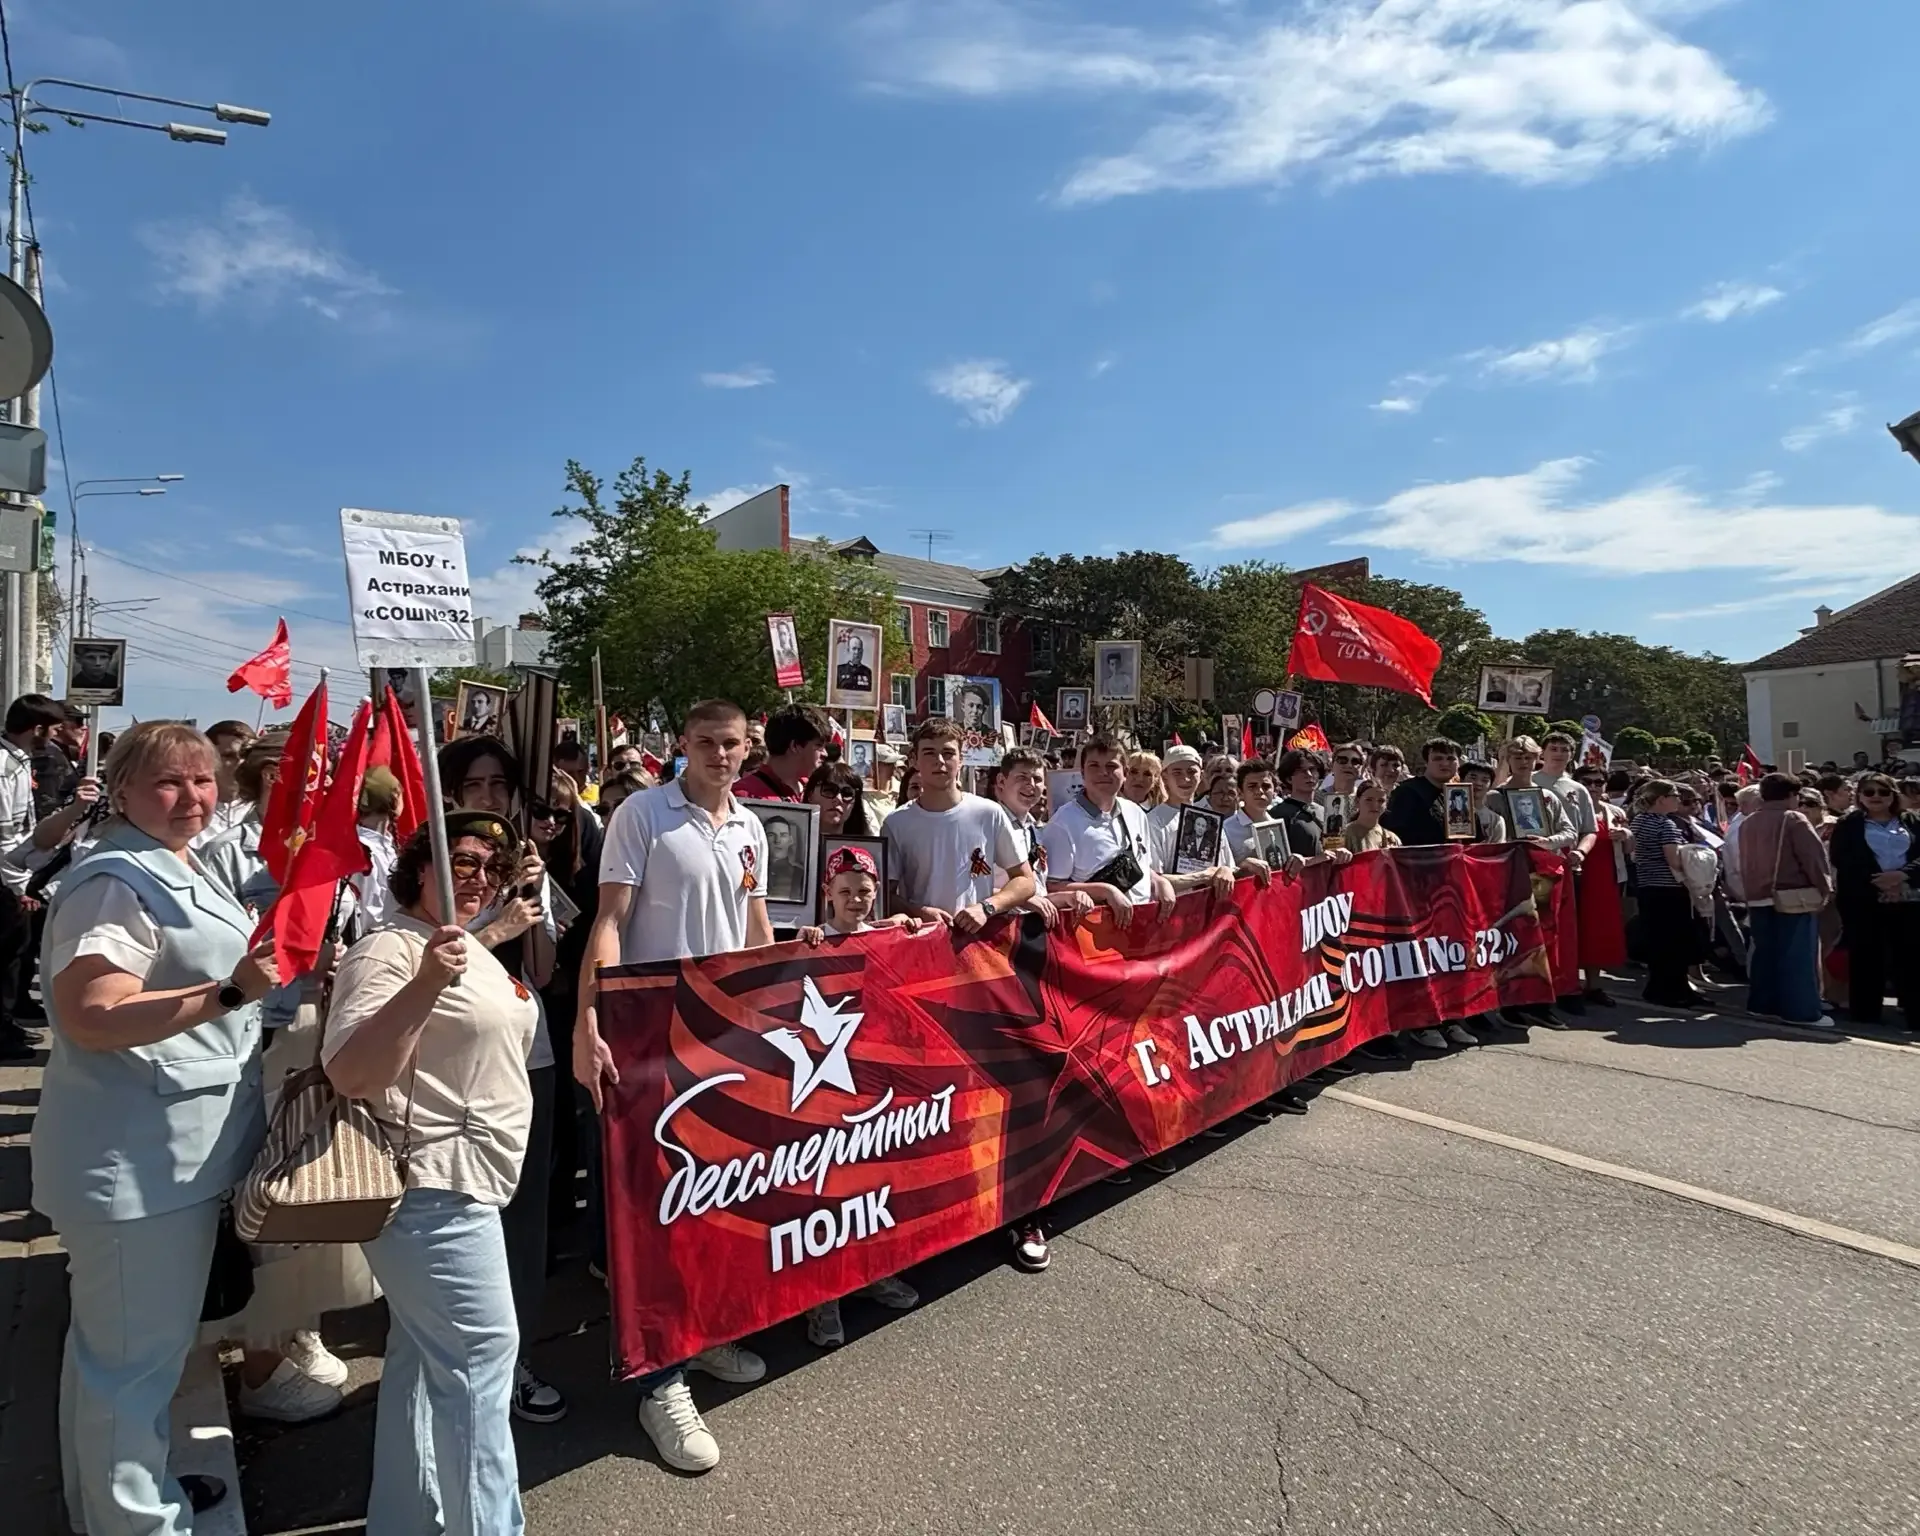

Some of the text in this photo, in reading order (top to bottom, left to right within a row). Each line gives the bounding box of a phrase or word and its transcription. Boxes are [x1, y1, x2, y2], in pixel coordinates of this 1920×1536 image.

[379, 550, 456, 570] МБОУ г.
[367, 577, 471, 597] Астрахани
[770, 1185, 896, 1273] ПОЛК
